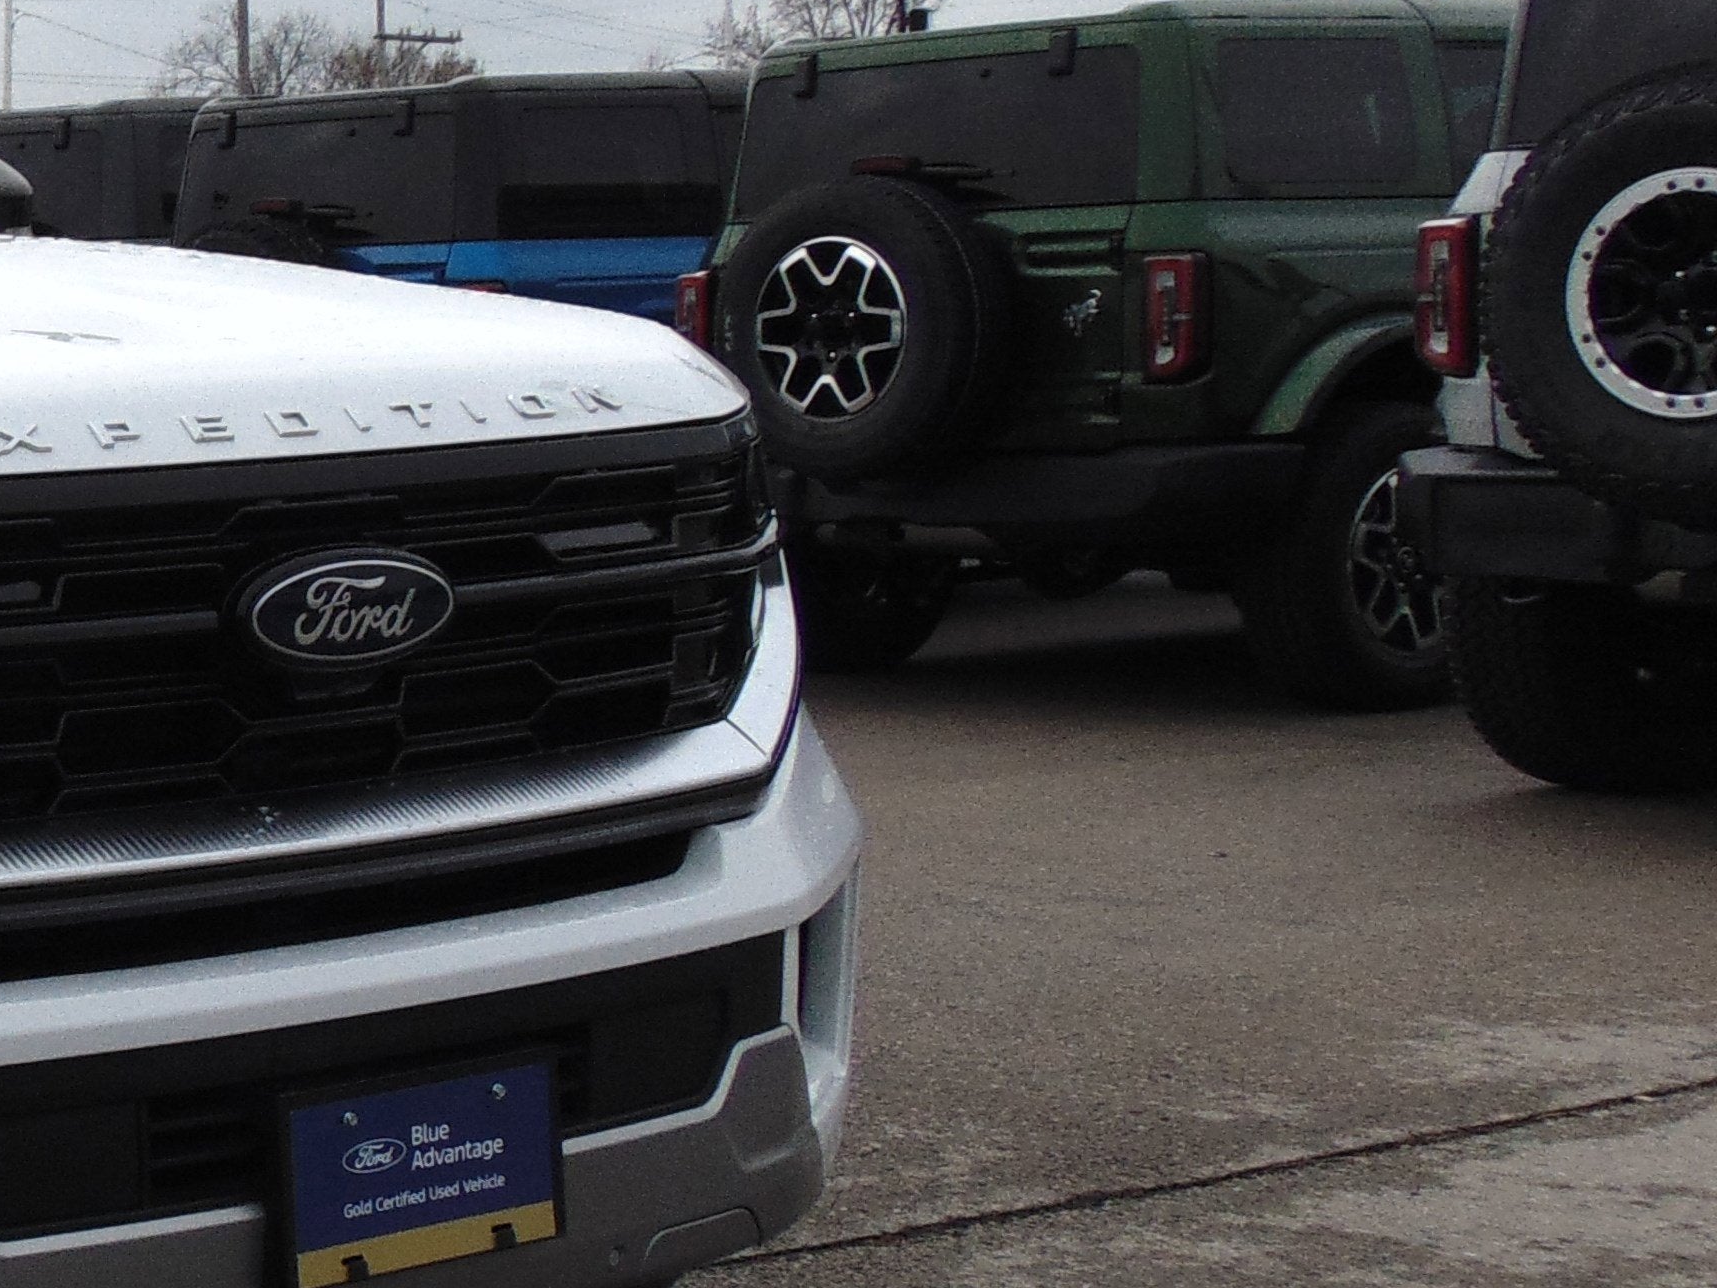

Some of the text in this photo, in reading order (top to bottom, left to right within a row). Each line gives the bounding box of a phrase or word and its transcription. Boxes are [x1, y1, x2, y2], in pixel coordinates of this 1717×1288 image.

[293, 574, 416, 646] Ford
[411, 1123, 450, 1146] Blue
[354, 1143, 394, 1169] Ford
[411, 1138, 504, 1171] Advantage
[343, 1173, 506, 1219] Gold Certified Used Vehicle
